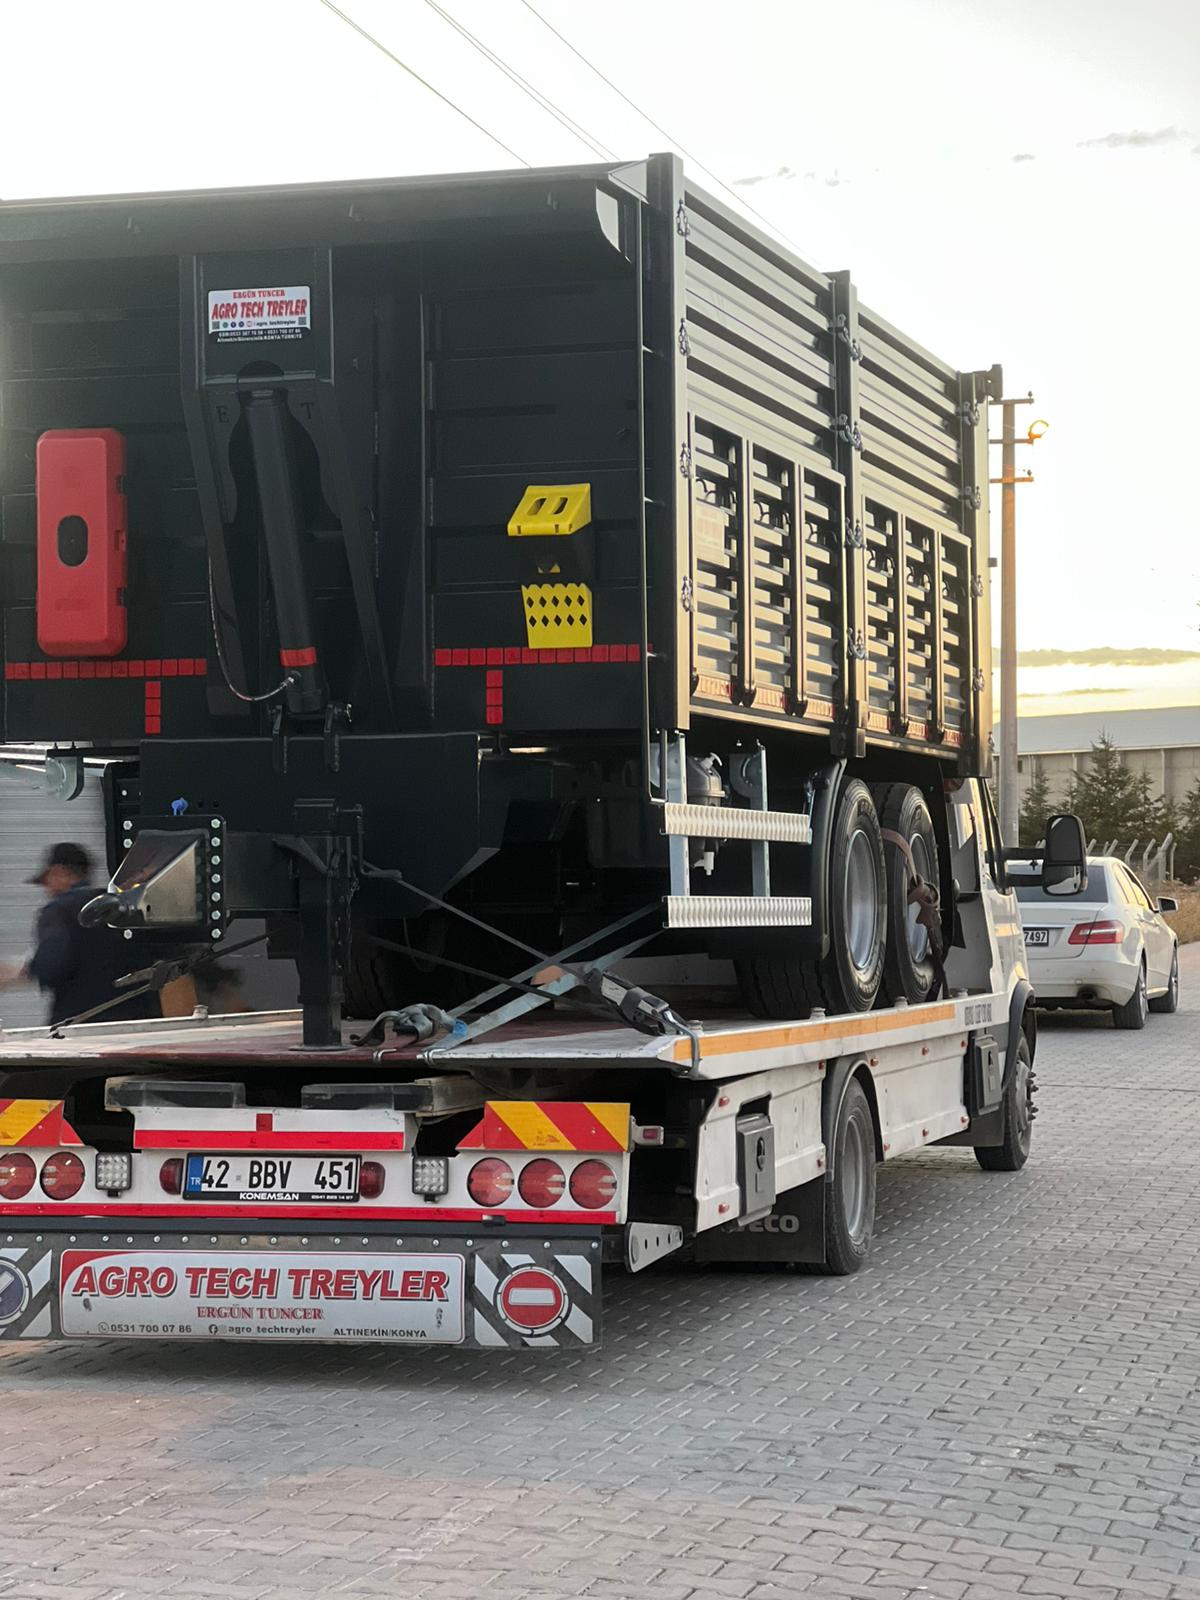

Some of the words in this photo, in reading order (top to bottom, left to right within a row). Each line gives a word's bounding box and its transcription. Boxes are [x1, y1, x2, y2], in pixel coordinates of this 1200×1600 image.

[258, 289, 285, 298] TUNCER
[211, 302, 238, 320] AGRO
[240, 301, 265, 319] TECH
[267, 299, 307, 317] TREYLER
[191, 1177, 200, 1186] TR
[202, 1160, 230, 1188] 42
[249, 1160, 292, 1189] BBV
[314, 1161, 354, 1190] 451
[239, 1191, 300, 1200] KONEMSAN
[71, 1265, 178, 1300] AGRO
[184, 1267, 280, 1300] TECH
[287, 1269, 450, 1302] TREYLER
[197, 1304, 253, 1319] ERGÜN
[256, 1307, 323, 1321] TUNCER
[110, 1324, 136, 1334] 0531
[138, 1324, 160, 1334] 700
[162, 1324, 175, 1334] 07
[178, 1325, 192, 1335] 86
